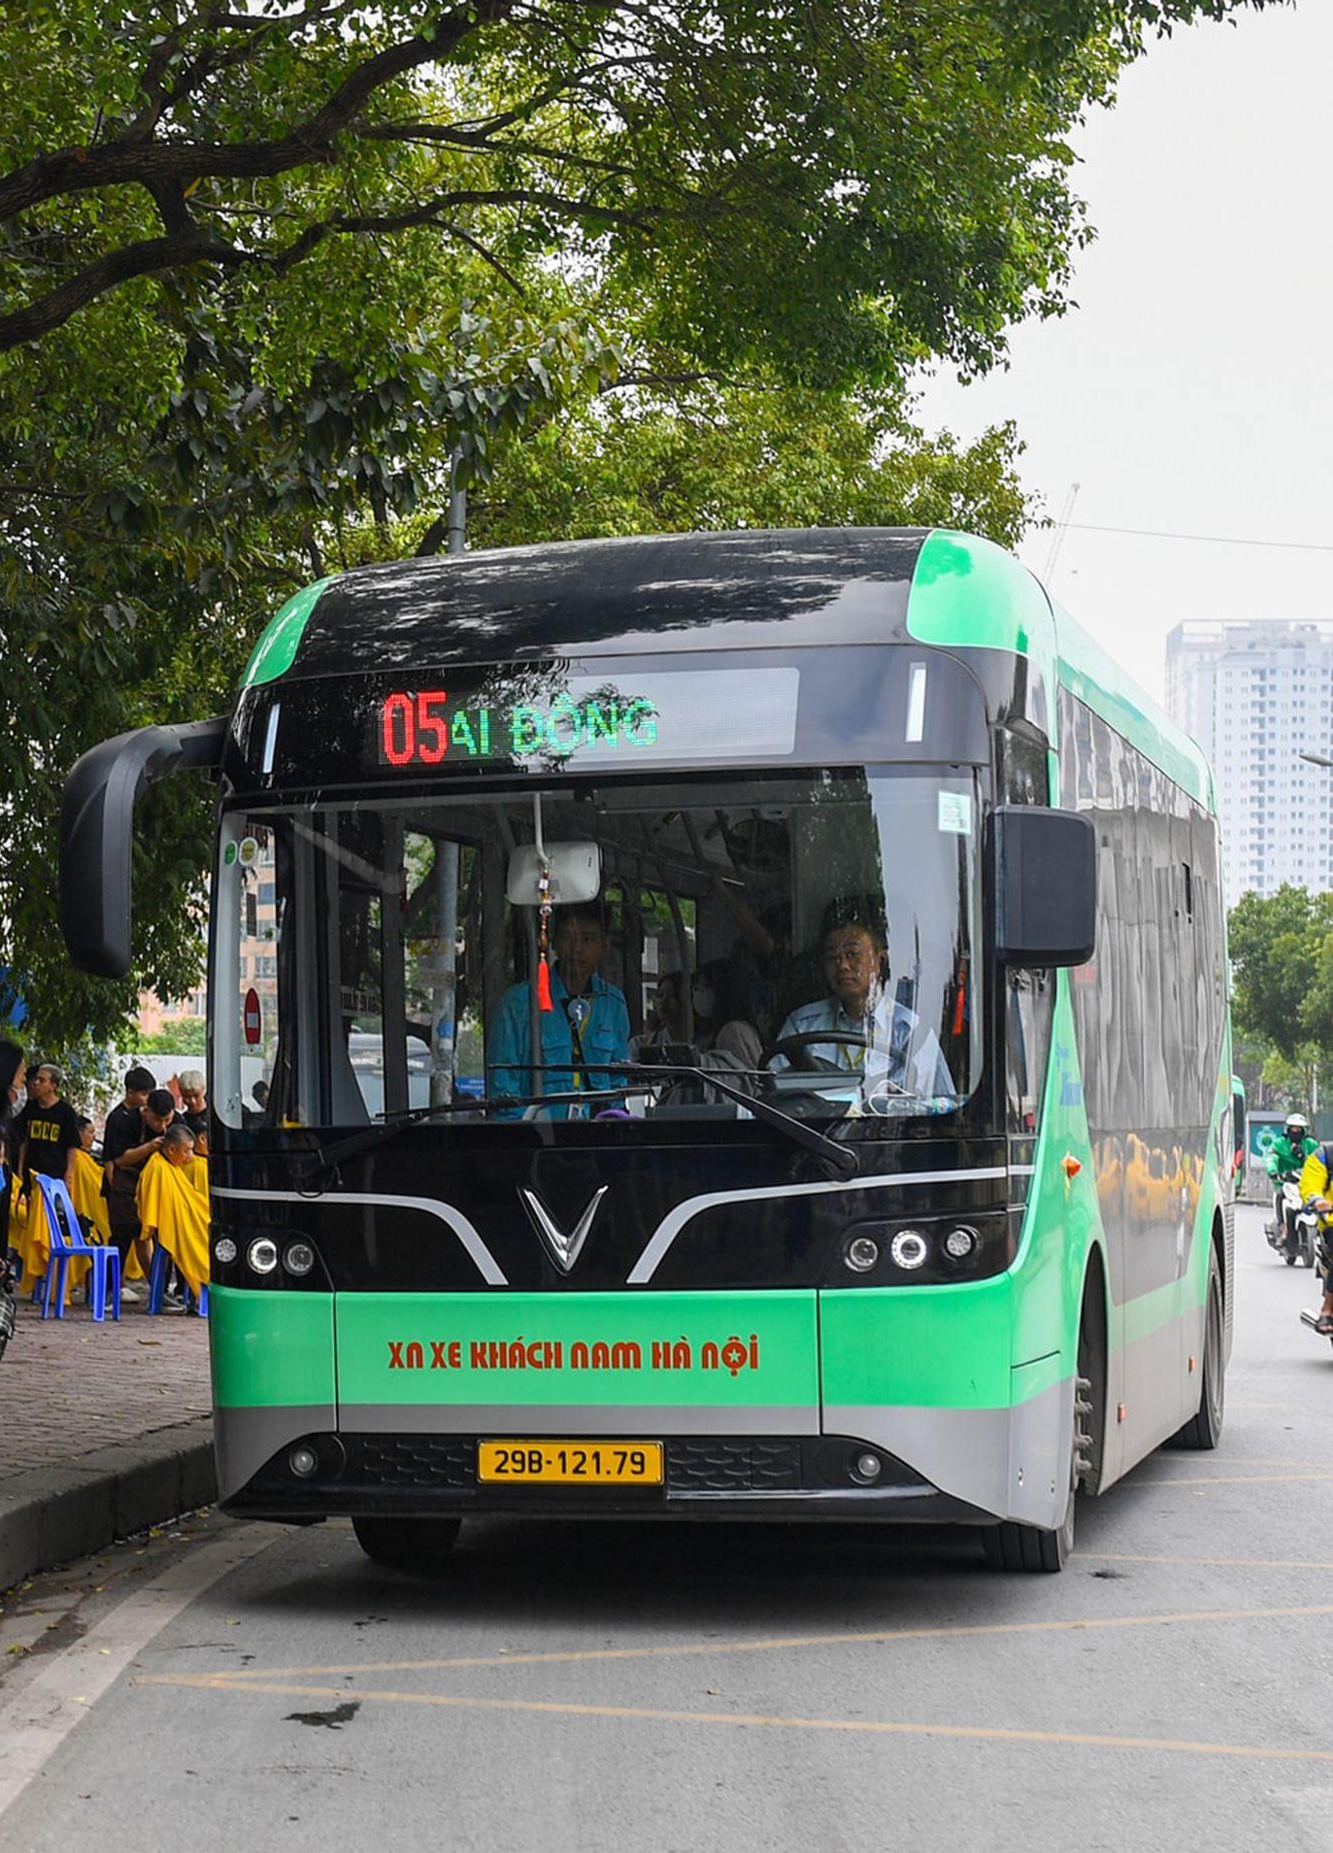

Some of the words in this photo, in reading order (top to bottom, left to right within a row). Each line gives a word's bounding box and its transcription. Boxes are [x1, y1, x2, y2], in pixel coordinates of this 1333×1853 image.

[383, 690, 449, 766] 05
[509, 691, 659, 755] ĐÔNG
[430, 1341, 461, 1369] XE
[470, 1336, 563, 1369] KHÁCH
[651, 1335, 692, 1369] HÀ
[701, 1333, 759, 1377] NỘI
[494, 1449, 646, 1476] 29B-121.79
